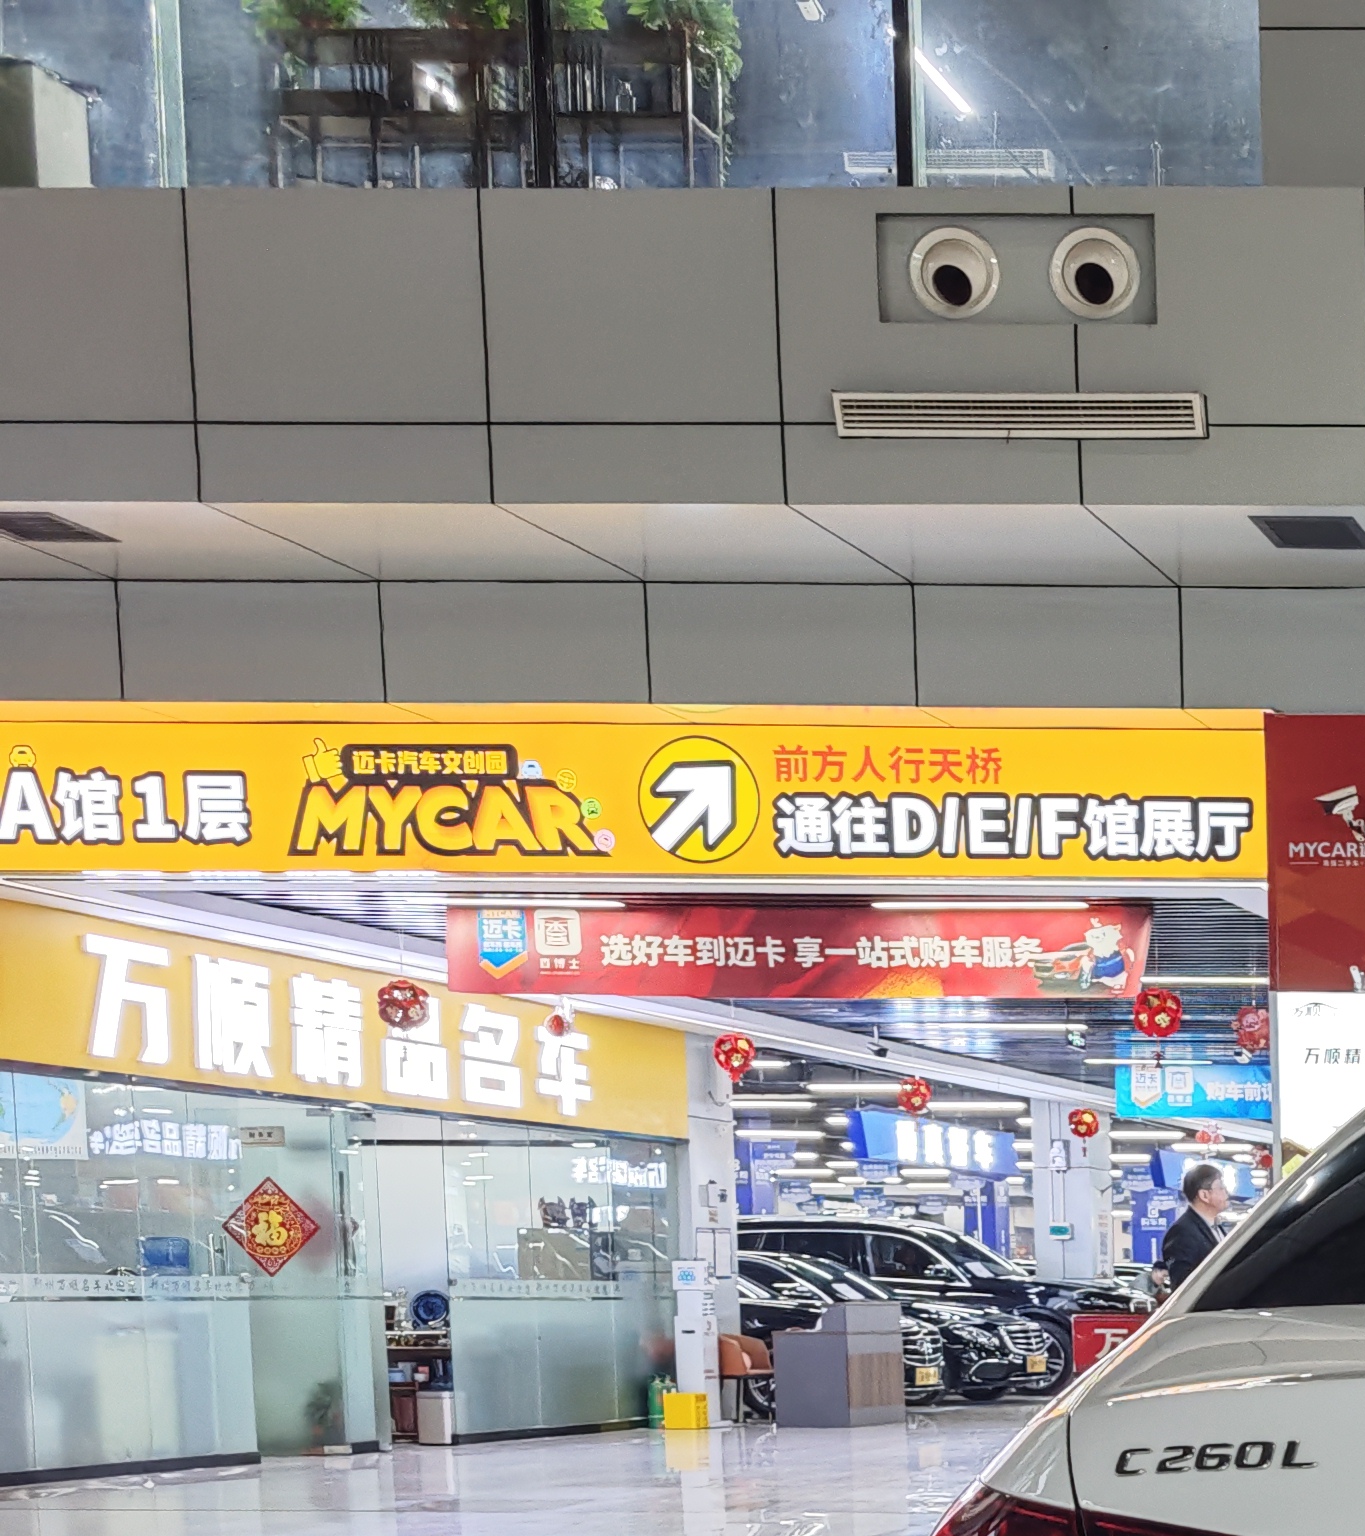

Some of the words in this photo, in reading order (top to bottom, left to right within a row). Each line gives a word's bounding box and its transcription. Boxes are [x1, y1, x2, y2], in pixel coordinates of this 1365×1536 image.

[352, 749, 509, 775] 迈卡汽车文创园
[773, 744, 1003, 785] 前方人行天桥
[0, 768, 251, 845] A馆1层
[291, 782, 610, 857] MYCAR
[772, 793, 1253, 861] 通往D/E/F馆展厅
[599, 933, 786, 968] 选好车到迈卡
[792, 934, 1044, 968] 享一站式购车服务
[82, 932, 593, 1117] 万顺精品名车
[251, 1209, 289, 1247] 福
